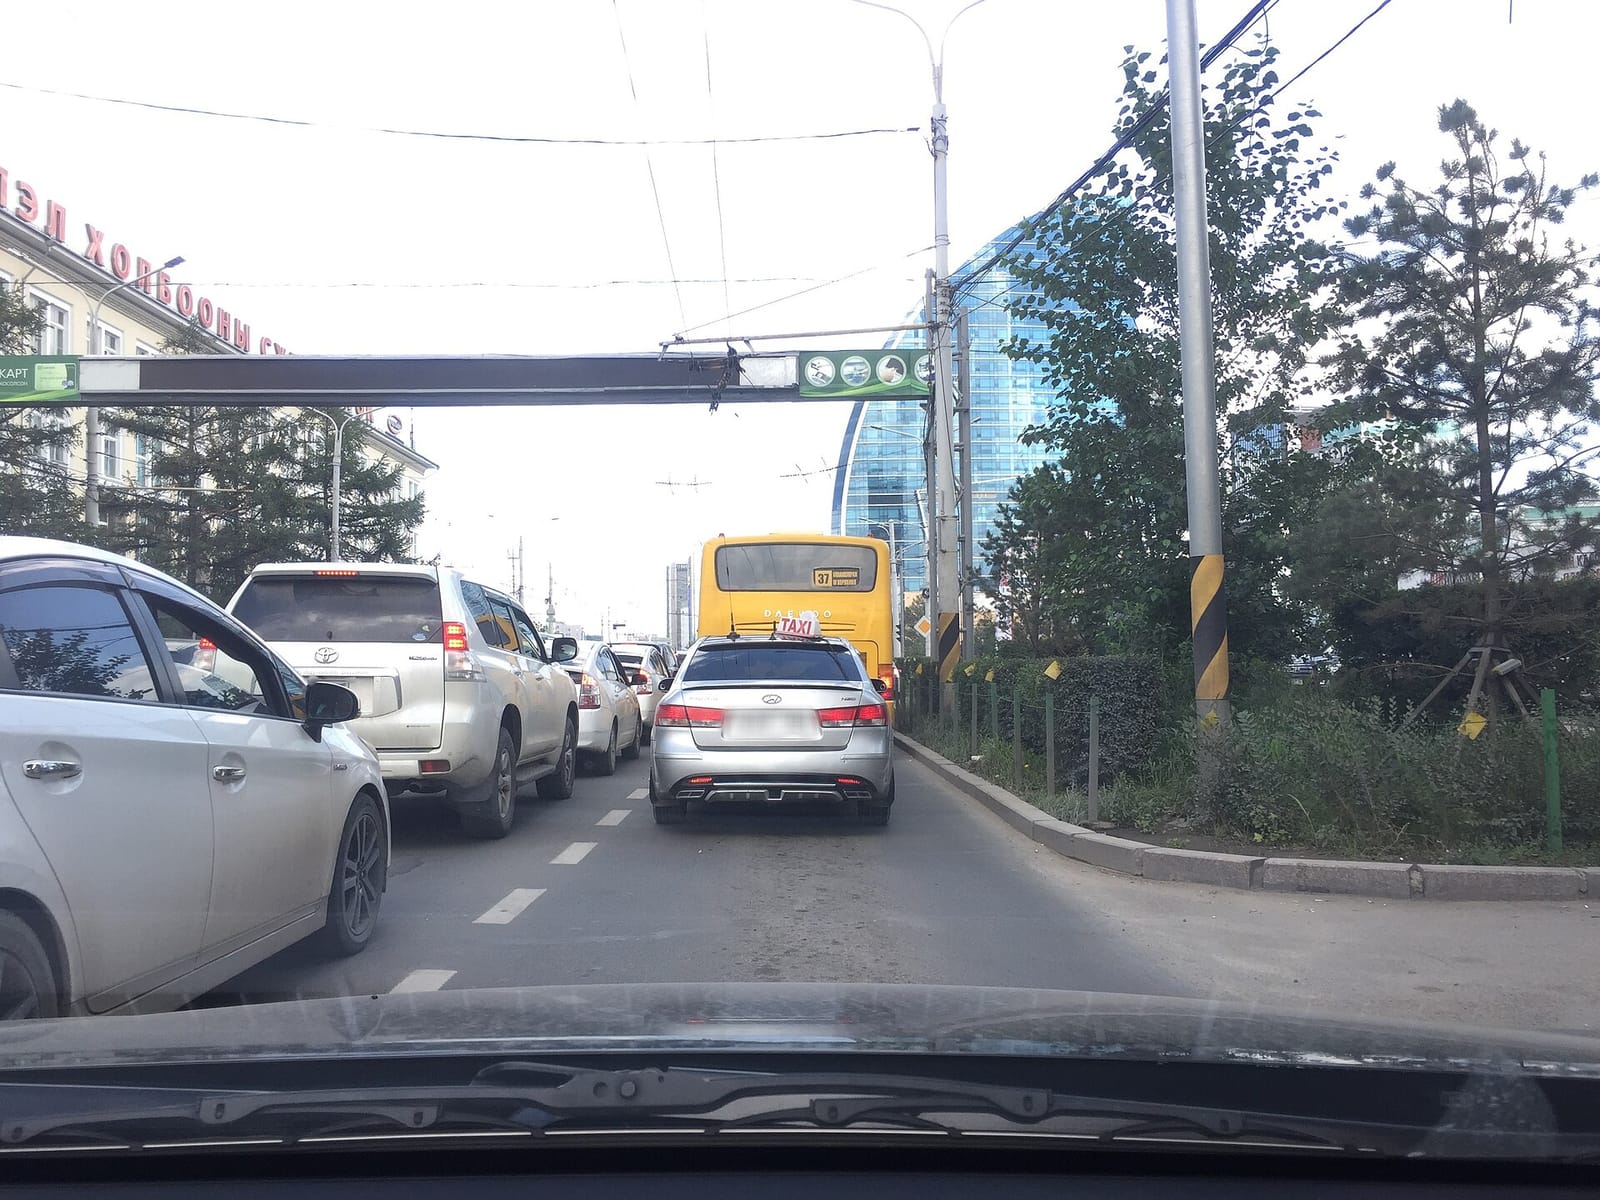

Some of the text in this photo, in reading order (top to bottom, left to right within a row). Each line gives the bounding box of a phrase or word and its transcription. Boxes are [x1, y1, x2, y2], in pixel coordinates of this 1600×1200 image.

[85, 223, 250, 352] ХОЛБООНЫ
[818, 573, 829, 585] 37
[781, 617, 812, 636] TAXI
